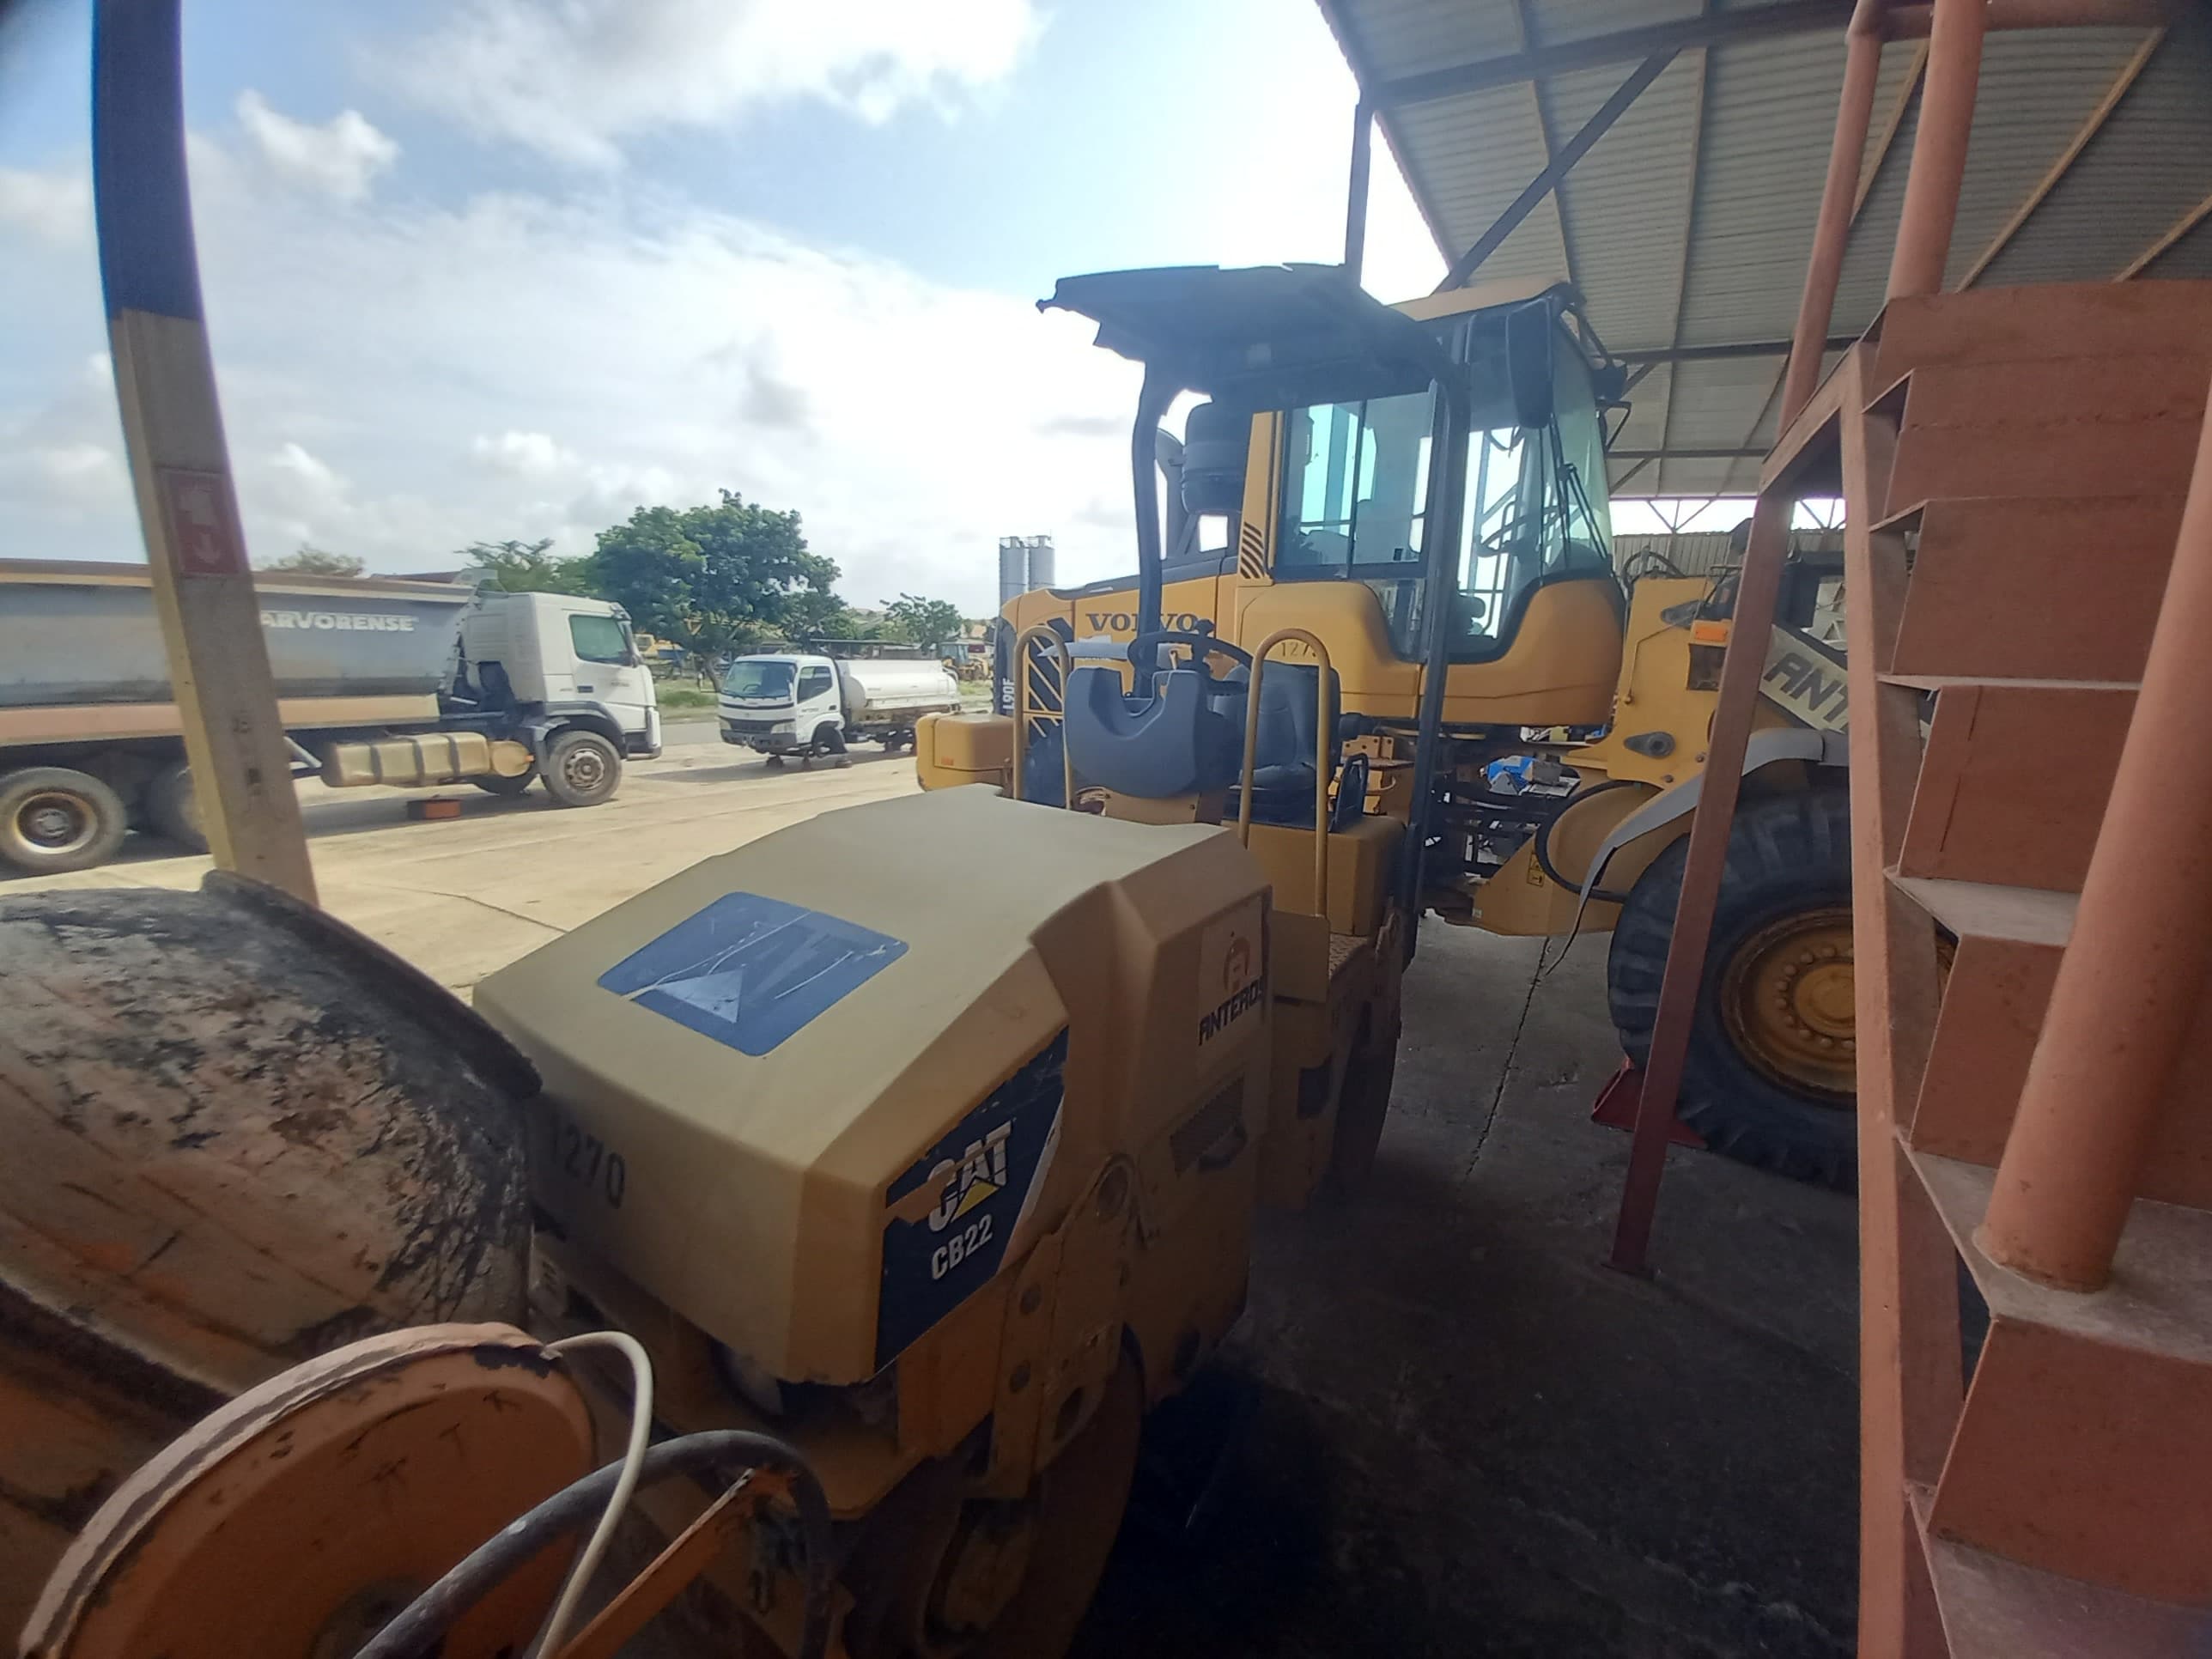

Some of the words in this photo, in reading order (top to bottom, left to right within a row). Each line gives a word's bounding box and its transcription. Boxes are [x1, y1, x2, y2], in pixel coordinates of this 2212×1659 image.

[1085, 612, 1199, 632] VOVO
[1281, 641, 1316, 658] 127
[1002, 678, 1015, 710] L90F
[1763, 652, 1848, 731] ANT
[932, 1213, 994, 1279] CB22
